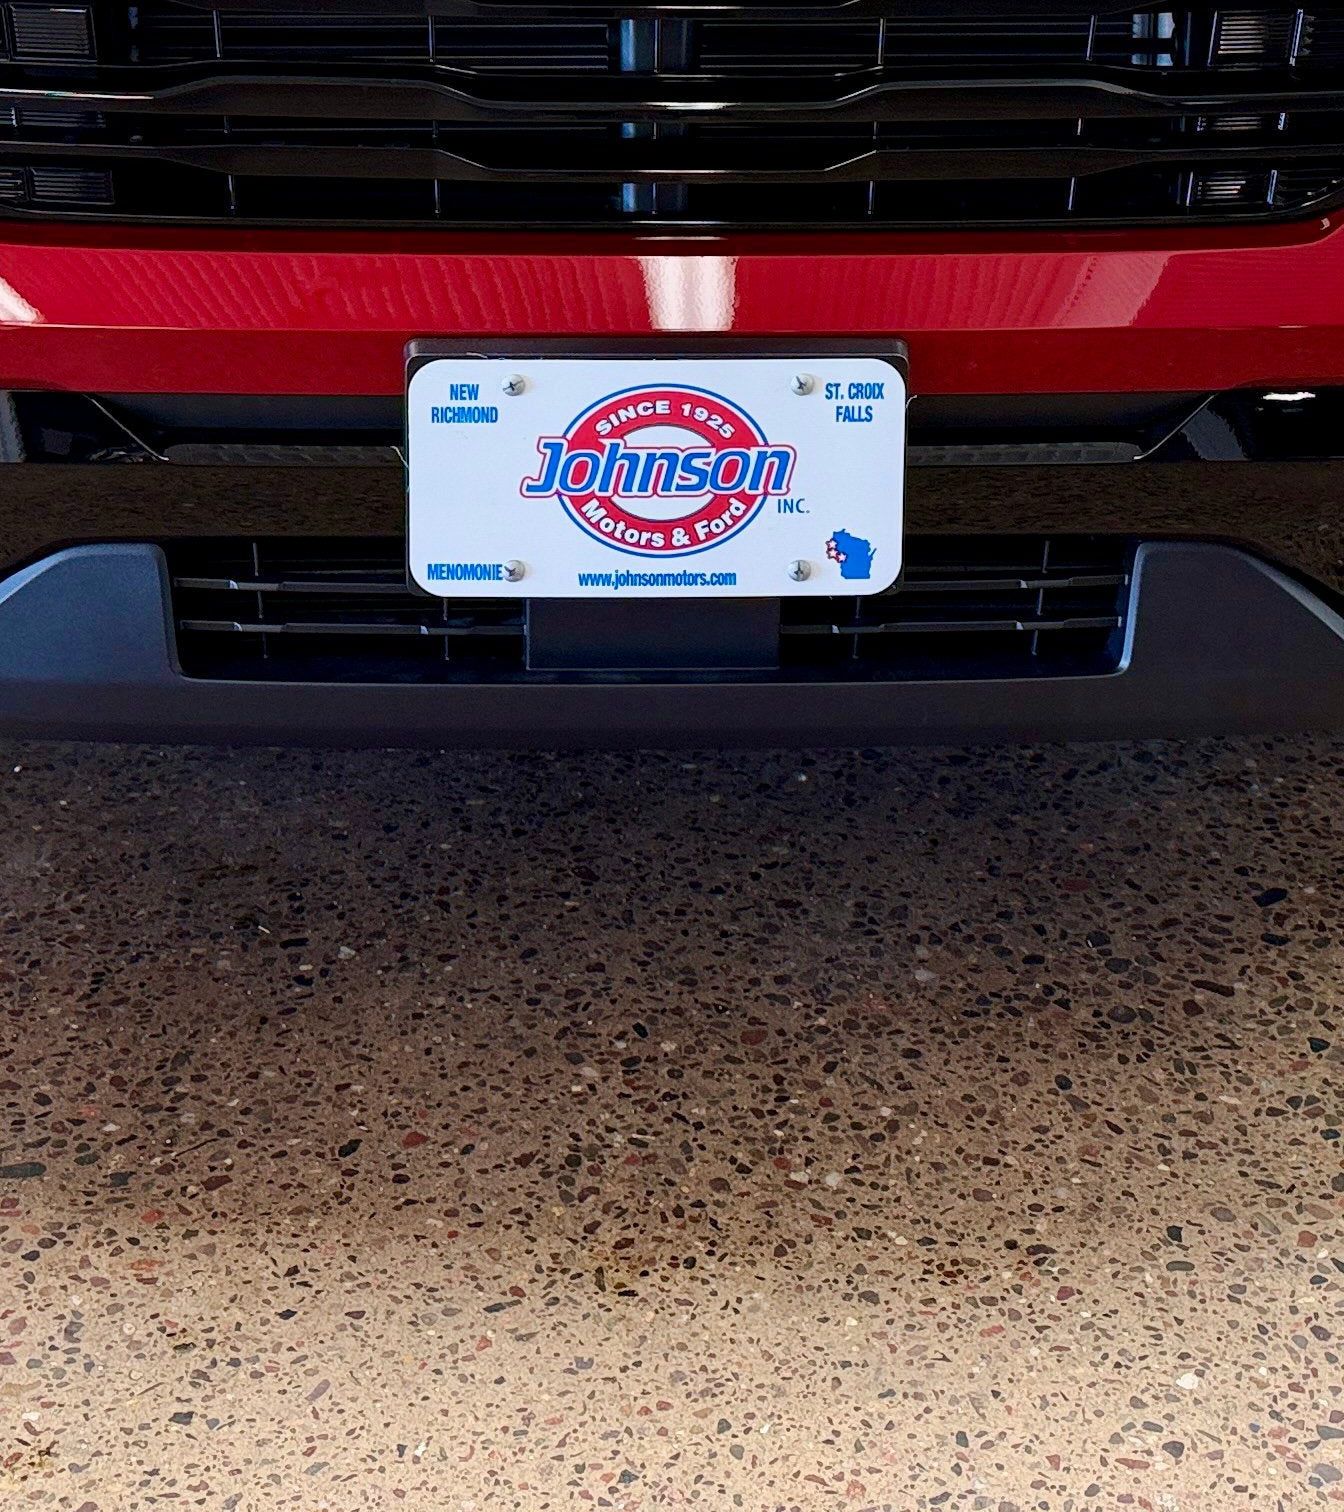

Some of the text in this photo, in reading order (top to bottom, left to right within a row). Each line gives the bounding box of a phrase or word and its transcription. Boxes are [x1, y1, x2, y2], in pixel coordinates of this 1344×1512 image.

[450, 383, 480, 401] NEW
[825, 382, 885, 400] ST. CROIX
[431, 406, 499, 423] RICHMOND
[594, 400, 737, 439] SINCE 1925
[836, 405, 873, 423] FALLS
[524, 441, 792, 493] Johnson
[777, 498, 811, 514] INC.
[580, 497, 748, 548] Motors & Ford
[427, 563, 504, 581] MENOMONIE
[577, 569, 737, 590] www.johnsonmotors.com
